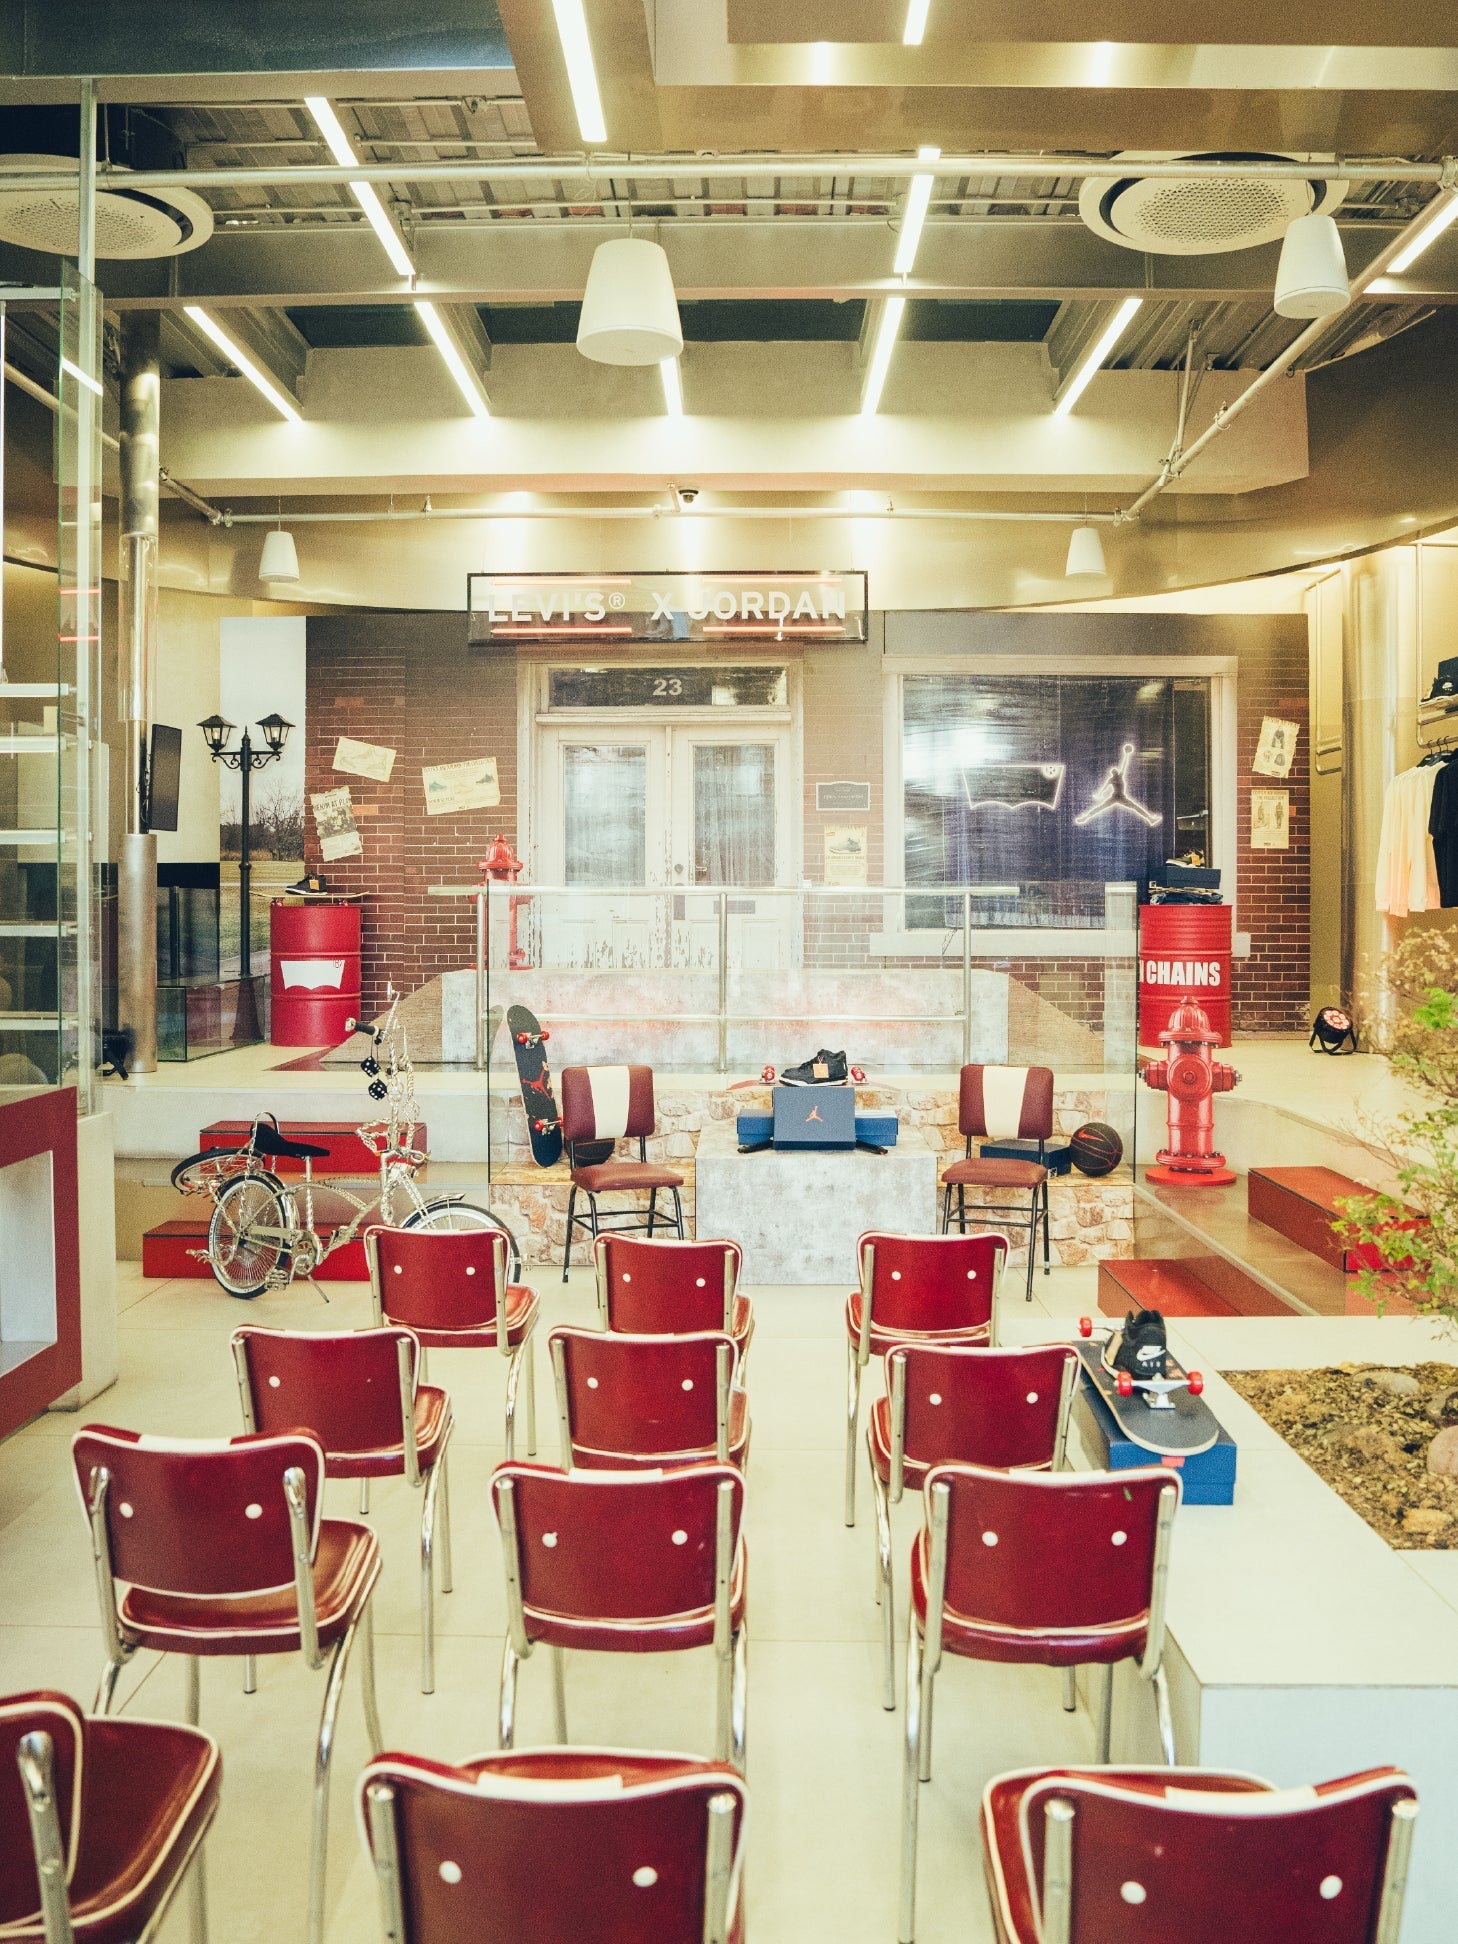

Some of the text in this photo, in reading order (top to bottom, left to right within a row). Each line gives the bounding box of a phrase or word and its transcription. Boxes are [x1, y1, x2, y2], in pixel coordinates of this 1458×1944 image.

[650, 592, 675, 620] X
[687, 590, 846, 620] JORDAN
[652, 678, 683, 696] 23
[1146, 960, 1221, 986] CHAINS
